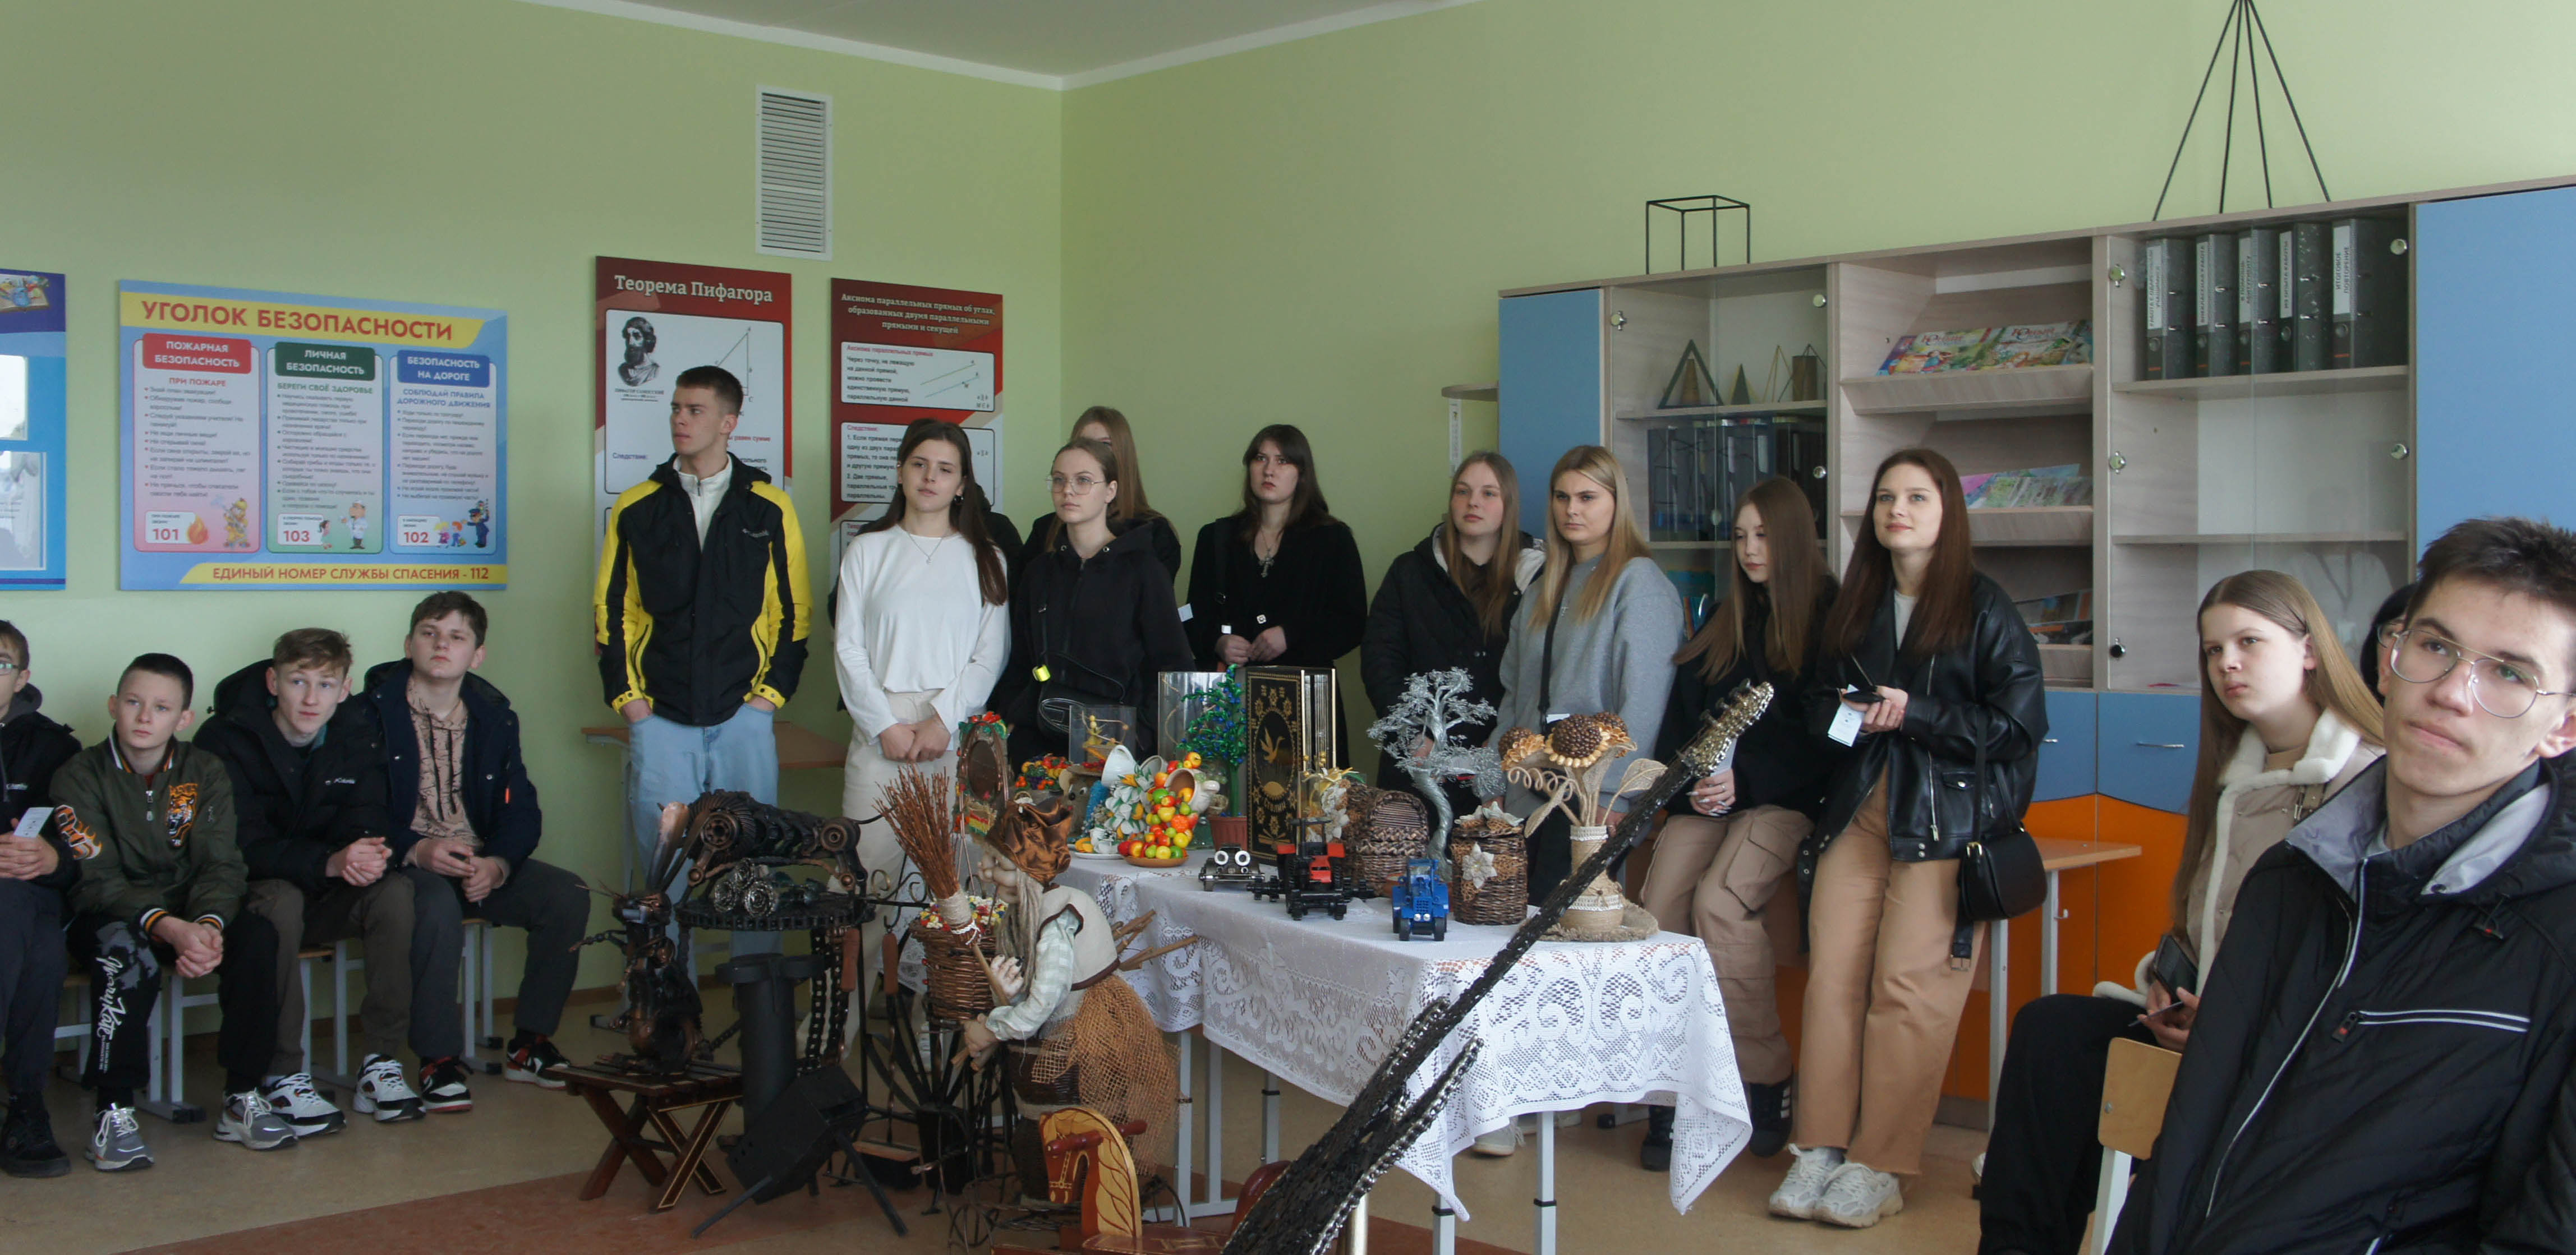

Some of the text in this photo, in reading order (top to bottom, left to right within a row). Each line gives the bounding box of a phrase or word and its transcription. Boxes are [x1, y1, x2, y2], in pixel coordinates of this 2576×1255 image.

[614, 275, 774, 305] Теорема Пифагора
[841, 293, 875, 303] Аксиома
[876, 297, 932, 310] параллельных
[934, 303, 962, 312] прямых
[973, 307, 995, 315] углах,
[141, 300, 452, 340] УГОЛОК БЕЗОПАСНОСТИ
[848, 305, 988, 326] образованных двумя параллельными
[882, 322, 918, 331] прямыми
[927, 325, 958, 334] секущей
[166, 341, 229, 352] ПОЖАРНАЯ
[154, 354, 240, 367] БЕЗОПАСНОСТЬ
[305, 349, 347, 362] ЛИЧНАЯ
[285, 362, 365, 376] БЕЗОПАСНОСТЬ
[407, 355, 480, 370] БЕЗОПАСНОСТЬ
[418, 369, 471, 382] НА ДОРОГЕ
[309, 384, 330, 392] СВОЁ
[332, 386, 373, 394] ЗДОРОВЬЕ
[403, 389, 448, 397] СОБЛЮДАЙ
[152, 528, 179, 541] 101
[283, 530, 310, 542] 103
[403, 531, 429, 543] 102
[213, 566, 274, 580] ЕДИНЫЙ
[278, 568, 326, 580] НОМЕР
[330, 568, 389, 580] СЛУЖБЫ
[393, 568, 459, 580] СПАСЕНИЯ
[470, 567, 489, 580] 112
